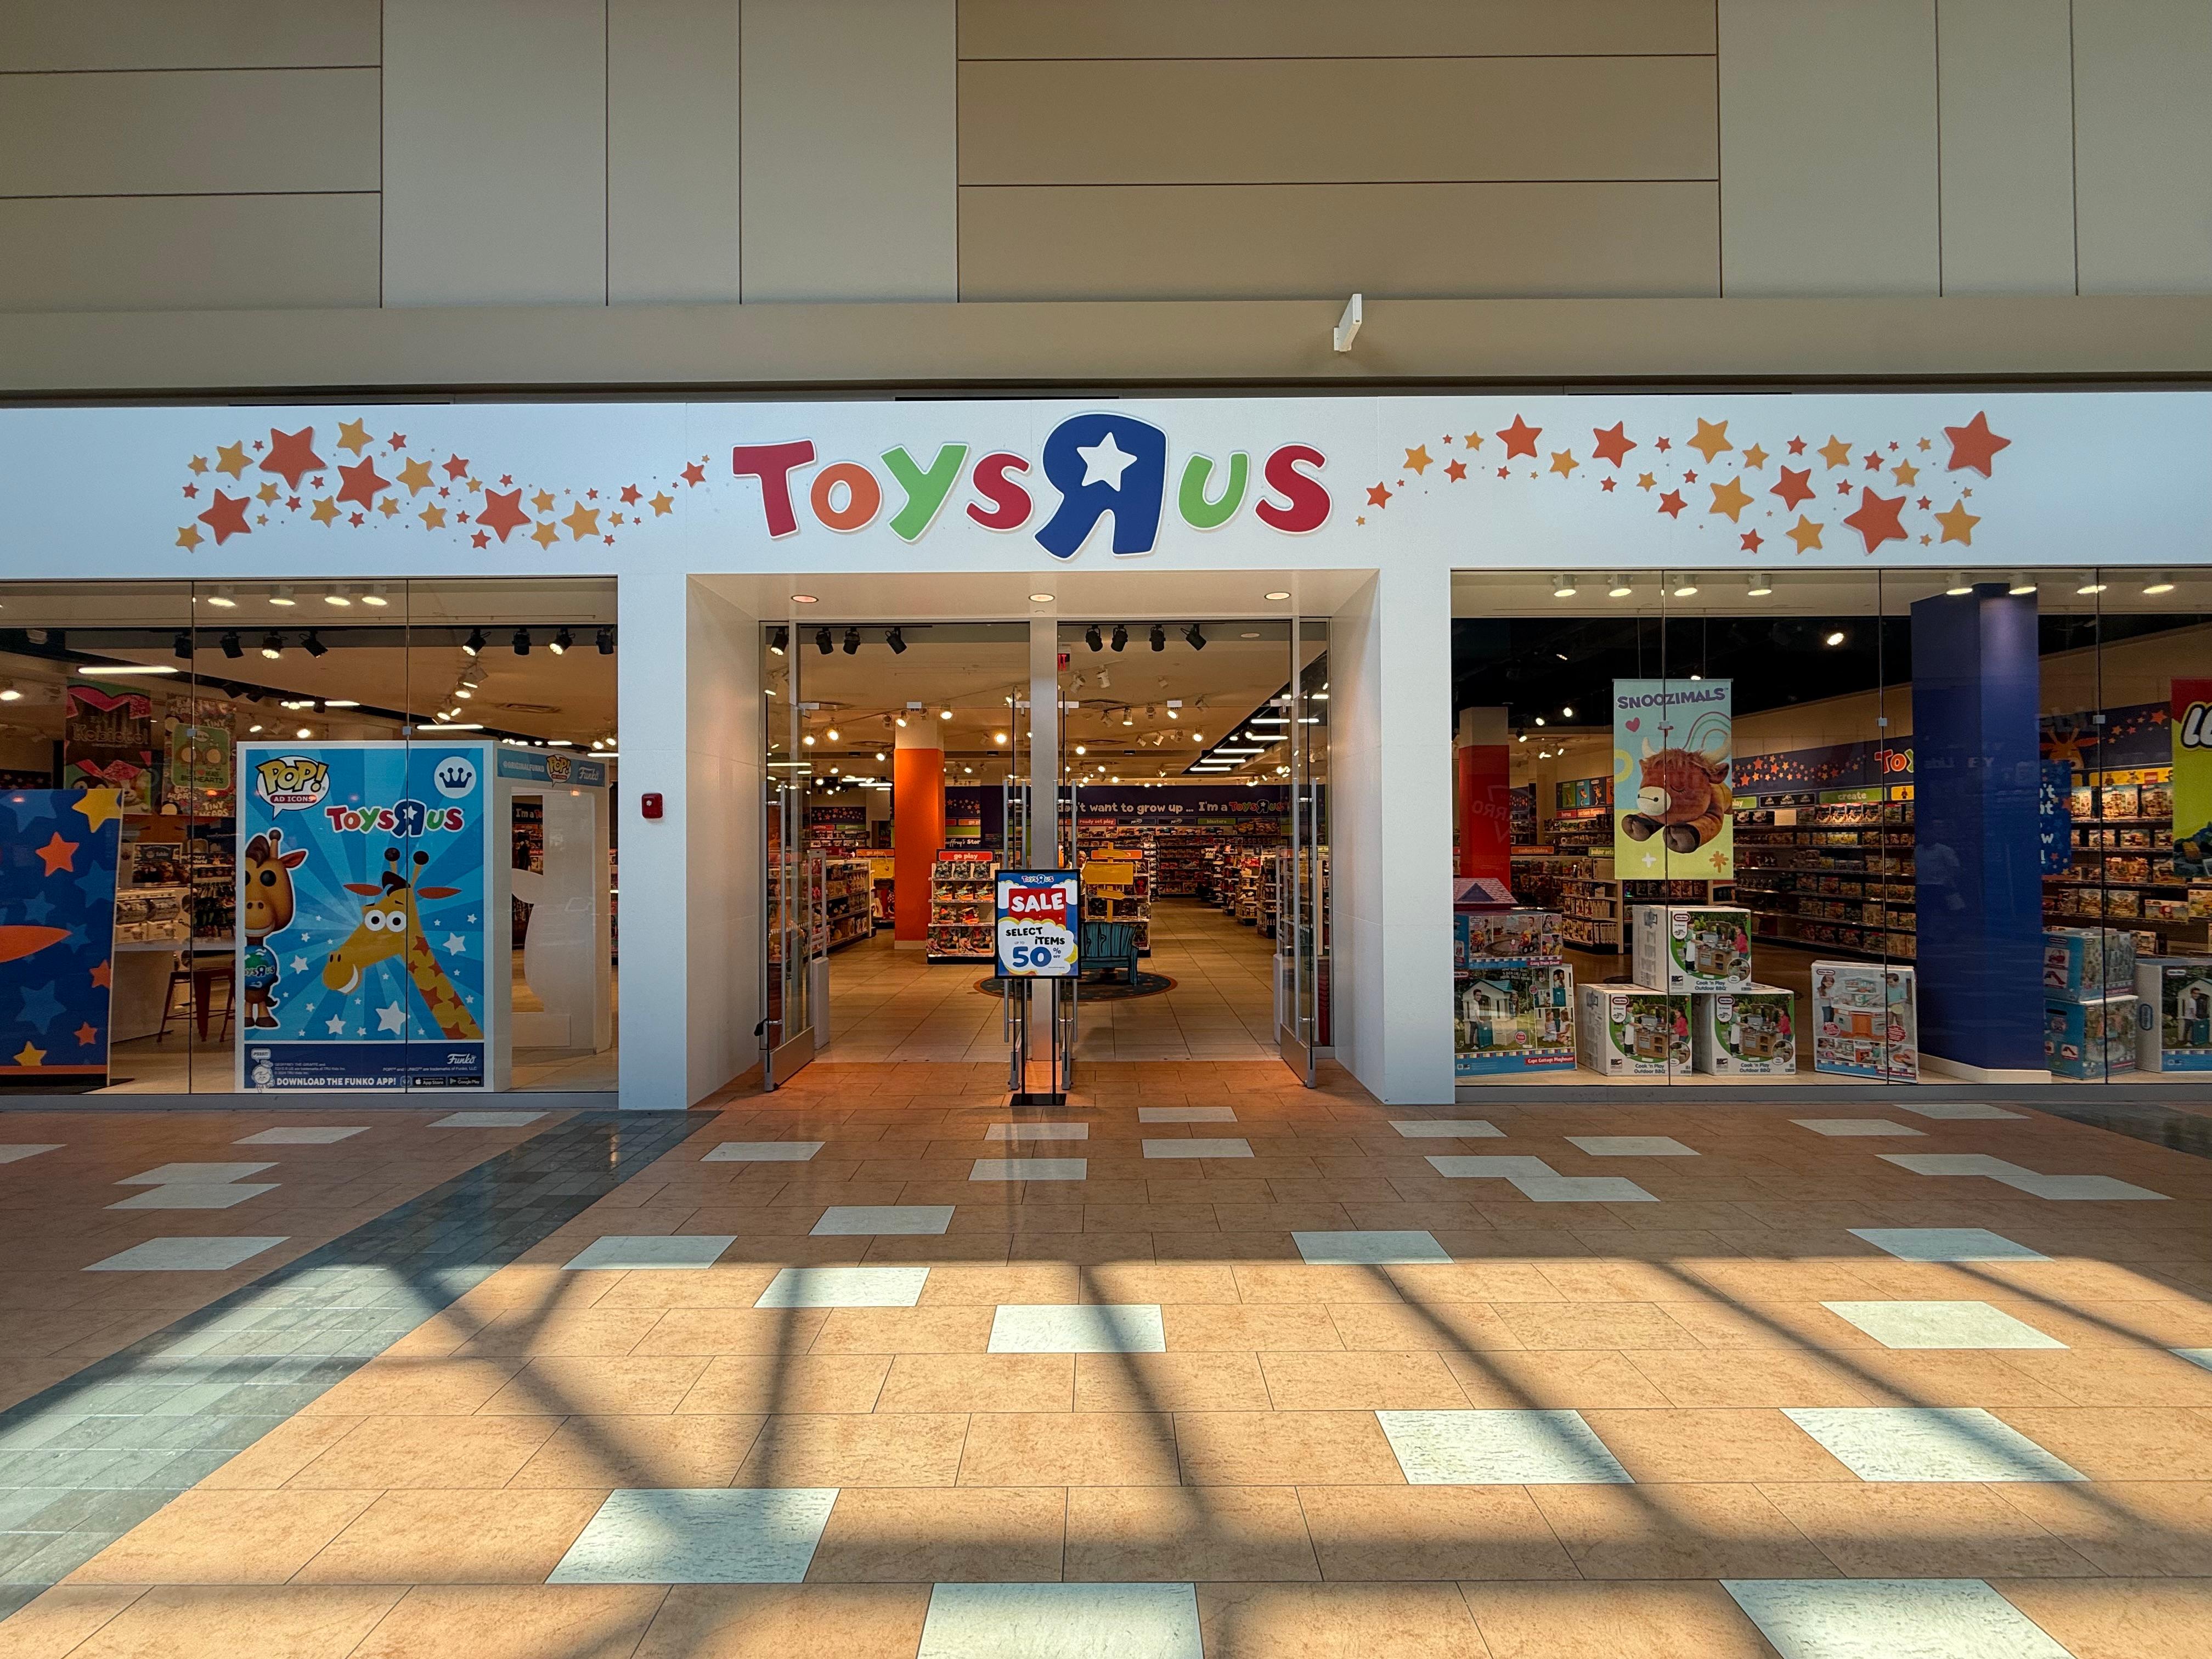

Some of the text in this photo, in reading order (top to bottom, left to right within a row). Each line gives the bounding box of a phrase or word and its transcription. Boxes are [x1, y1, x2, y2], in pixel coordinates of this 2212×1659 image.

[1058, 654, 1066, 671] IT
[1617, 687, 1725, 709] SNOOZIMALS
[1838, 792, 1867, 800] create
[1090, 803, 1118, 812] want
[1121, 803, 1134, 812] to
[1137, 804, 1166, 815] grow
[1168, 804, 1183, 815] up
[1011, 893, 1064, 912] SALE
[1006, 927, 1043, 936] SELECT
[447, 1053, 476, 1064] Funko
[276, 1077, 396, 1086] DOWNLOAD THE FUNKO APP!
